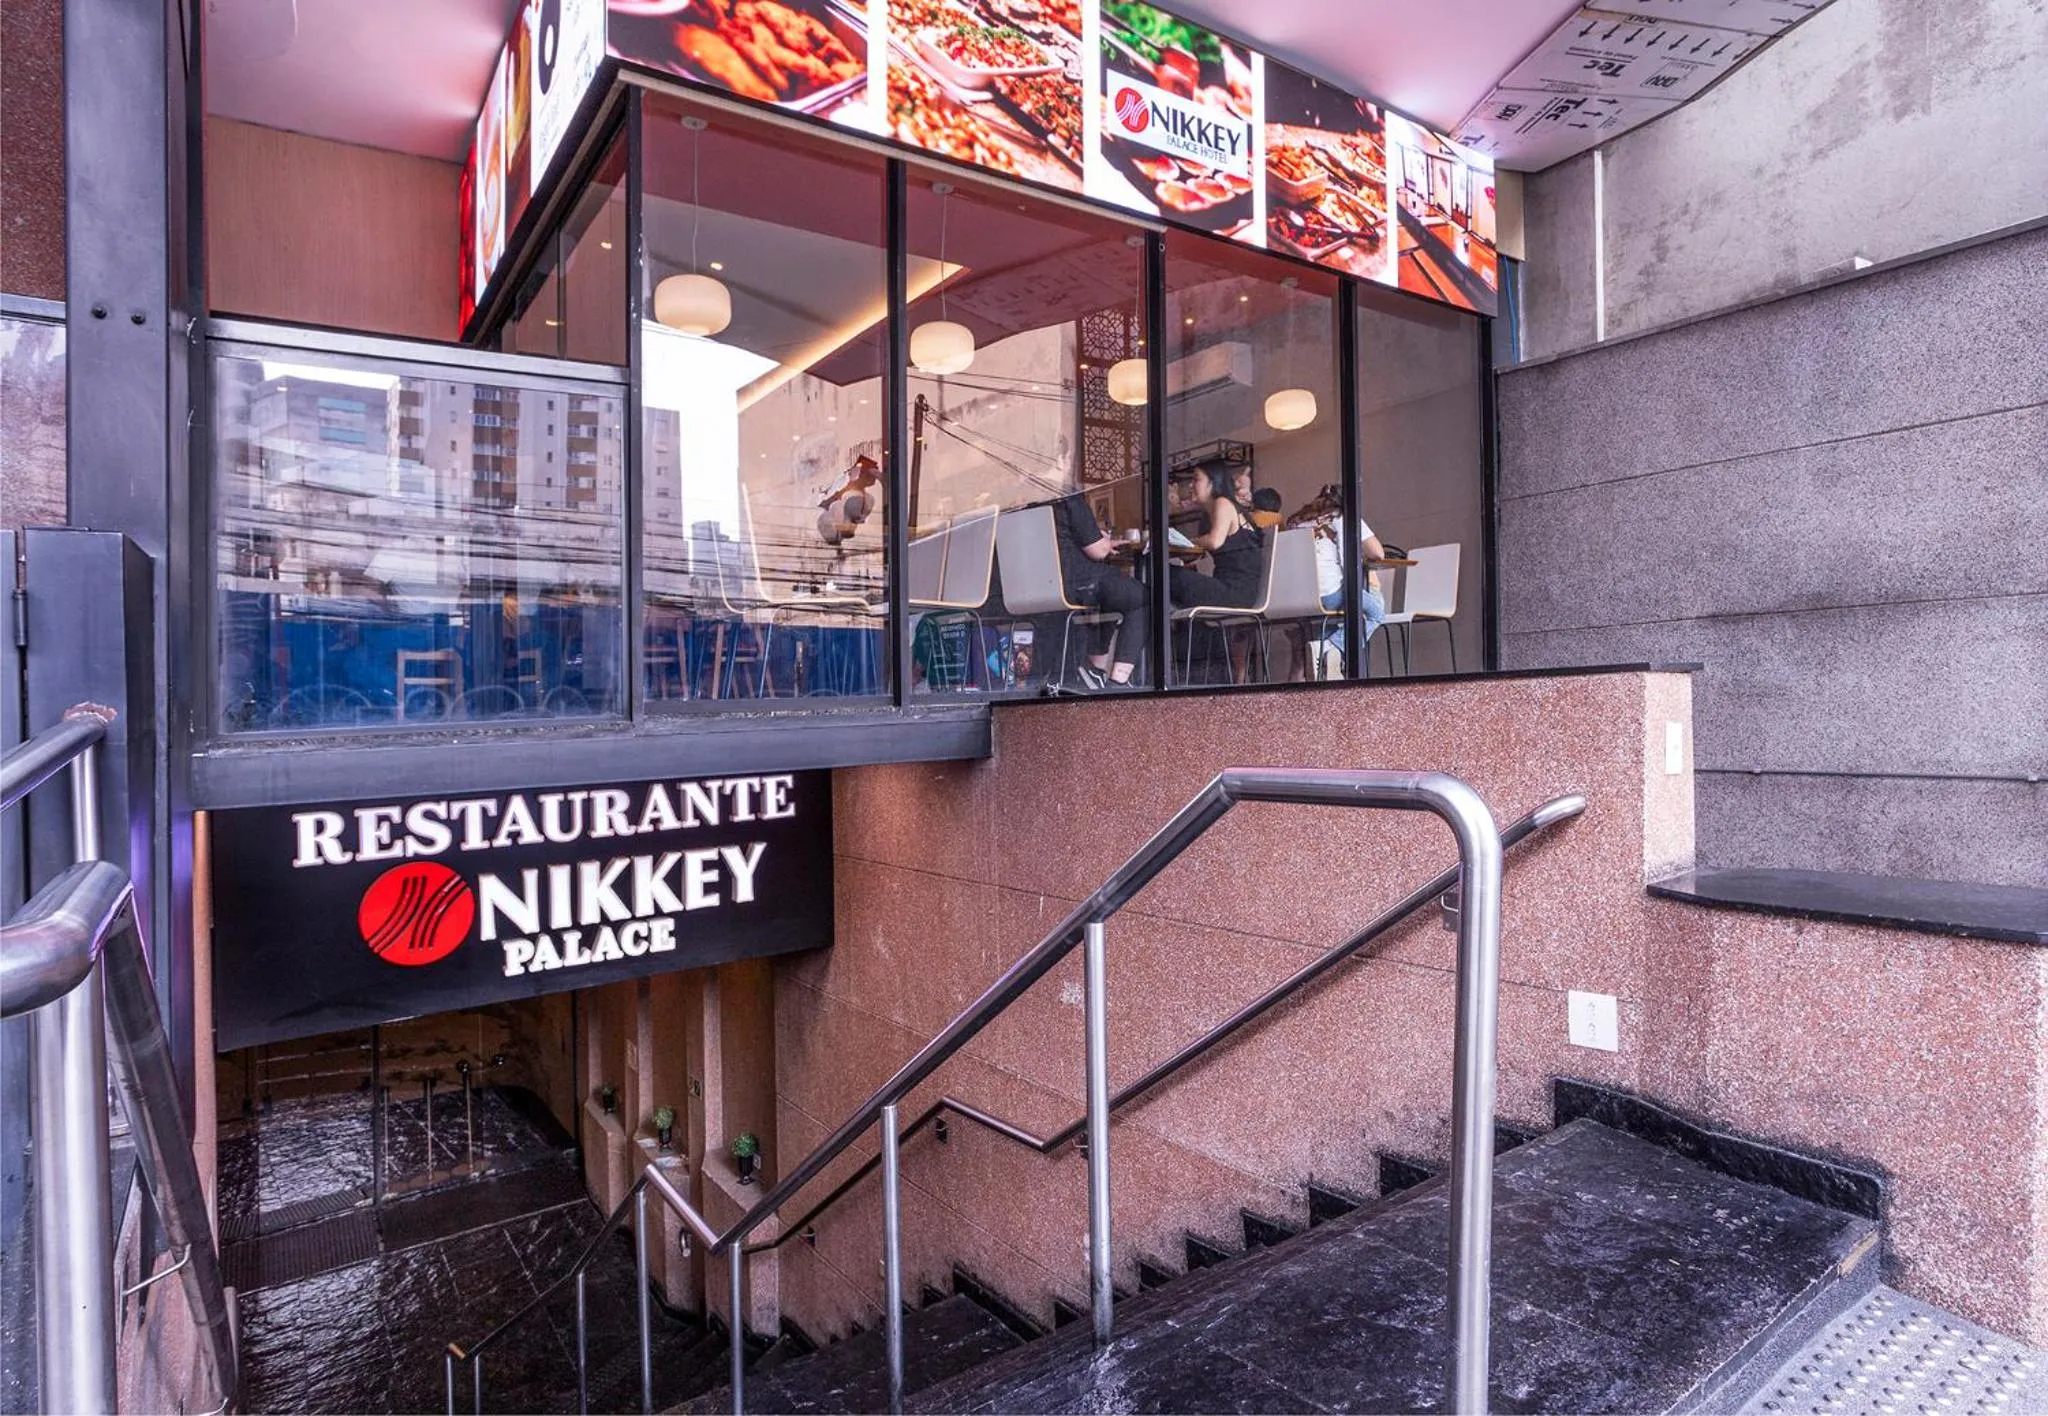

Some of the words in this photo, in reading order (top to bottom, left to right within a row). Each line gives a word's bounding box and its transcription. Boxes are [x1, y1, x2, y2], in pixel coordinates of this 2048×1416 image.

[1151, 100, 1241, 155] NIKKEY
[1166, 134, 1199, 155] PALACE
[1200, 147, 1228, 164] HOTEL
[291, 773, 798, 868] RESTAURANTE
[478, 841, 769, 942] NIKKEY
[502, 916, 677, 977] PALACE
